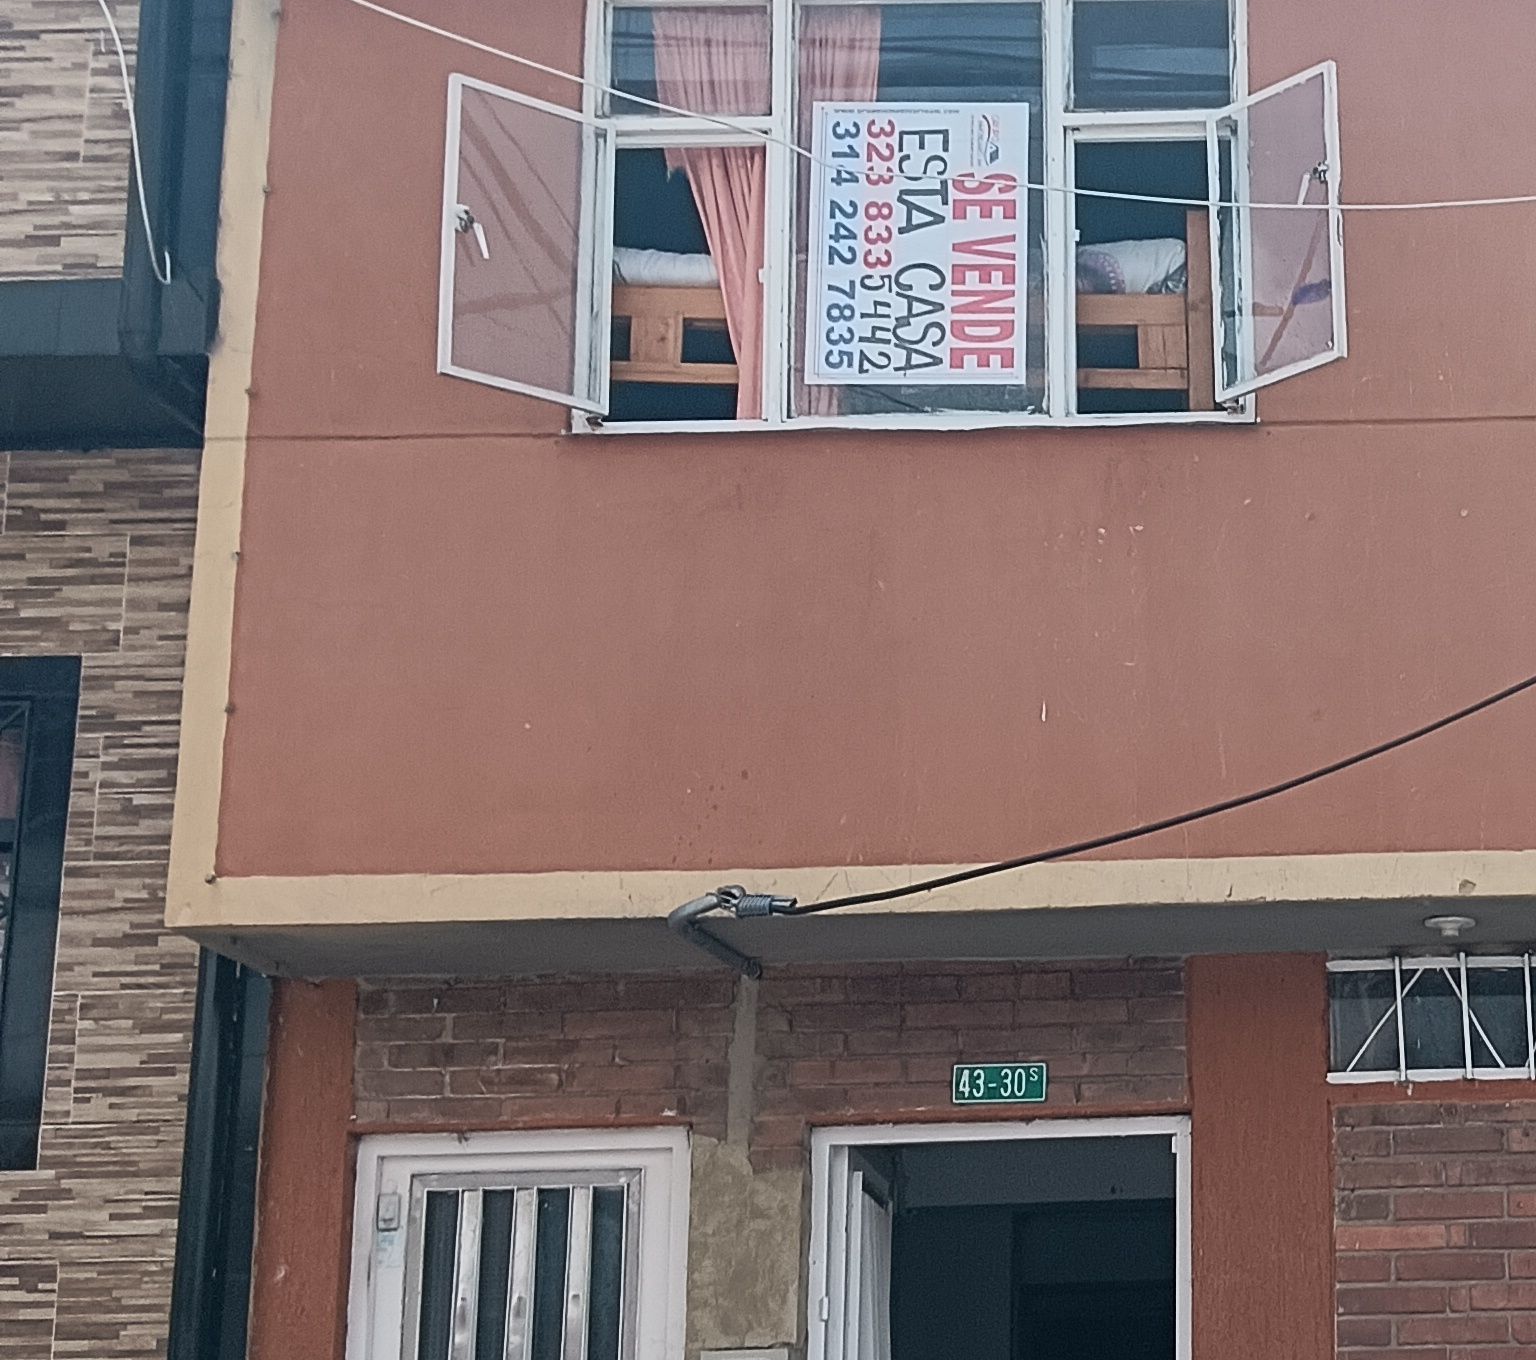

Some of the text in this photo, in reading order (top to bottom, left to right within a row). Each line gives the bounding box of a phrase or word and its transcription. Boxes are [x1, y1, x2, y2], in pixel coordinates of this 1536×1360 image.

[897, 129, 949, 235] ESTA
[951, 172, 1017, 220] SE
[824, 120, 861, 370] 314 242 7835
[858, 119, 896, 374] 323 833 5442
[949, 234, 1016, 369] VENDE
[892, 263, 946, 373] CASA
